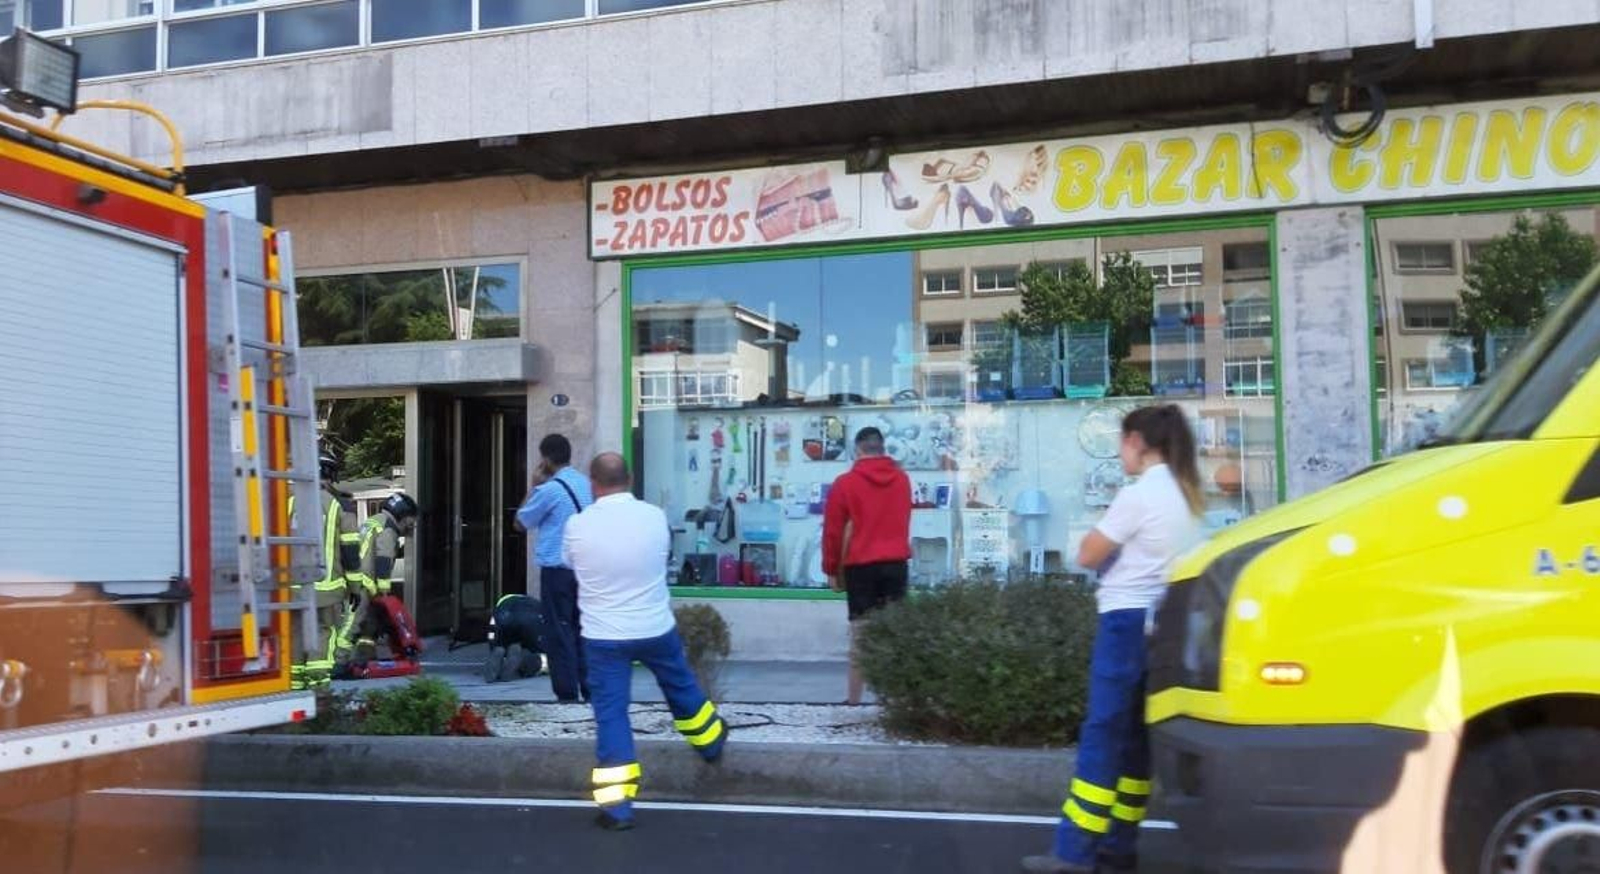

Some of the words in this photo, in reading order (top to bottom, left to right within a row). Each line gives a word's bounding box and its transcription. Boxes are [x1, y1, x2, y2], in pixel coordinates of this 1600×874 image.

[1053, 130, 1301, 211] BAZAR
[1330, 102, 1600, 191] CHINO
[596, 177, 731, 215] -BOLSOS
[596, 211, 749, 250] -ZAPATOS
